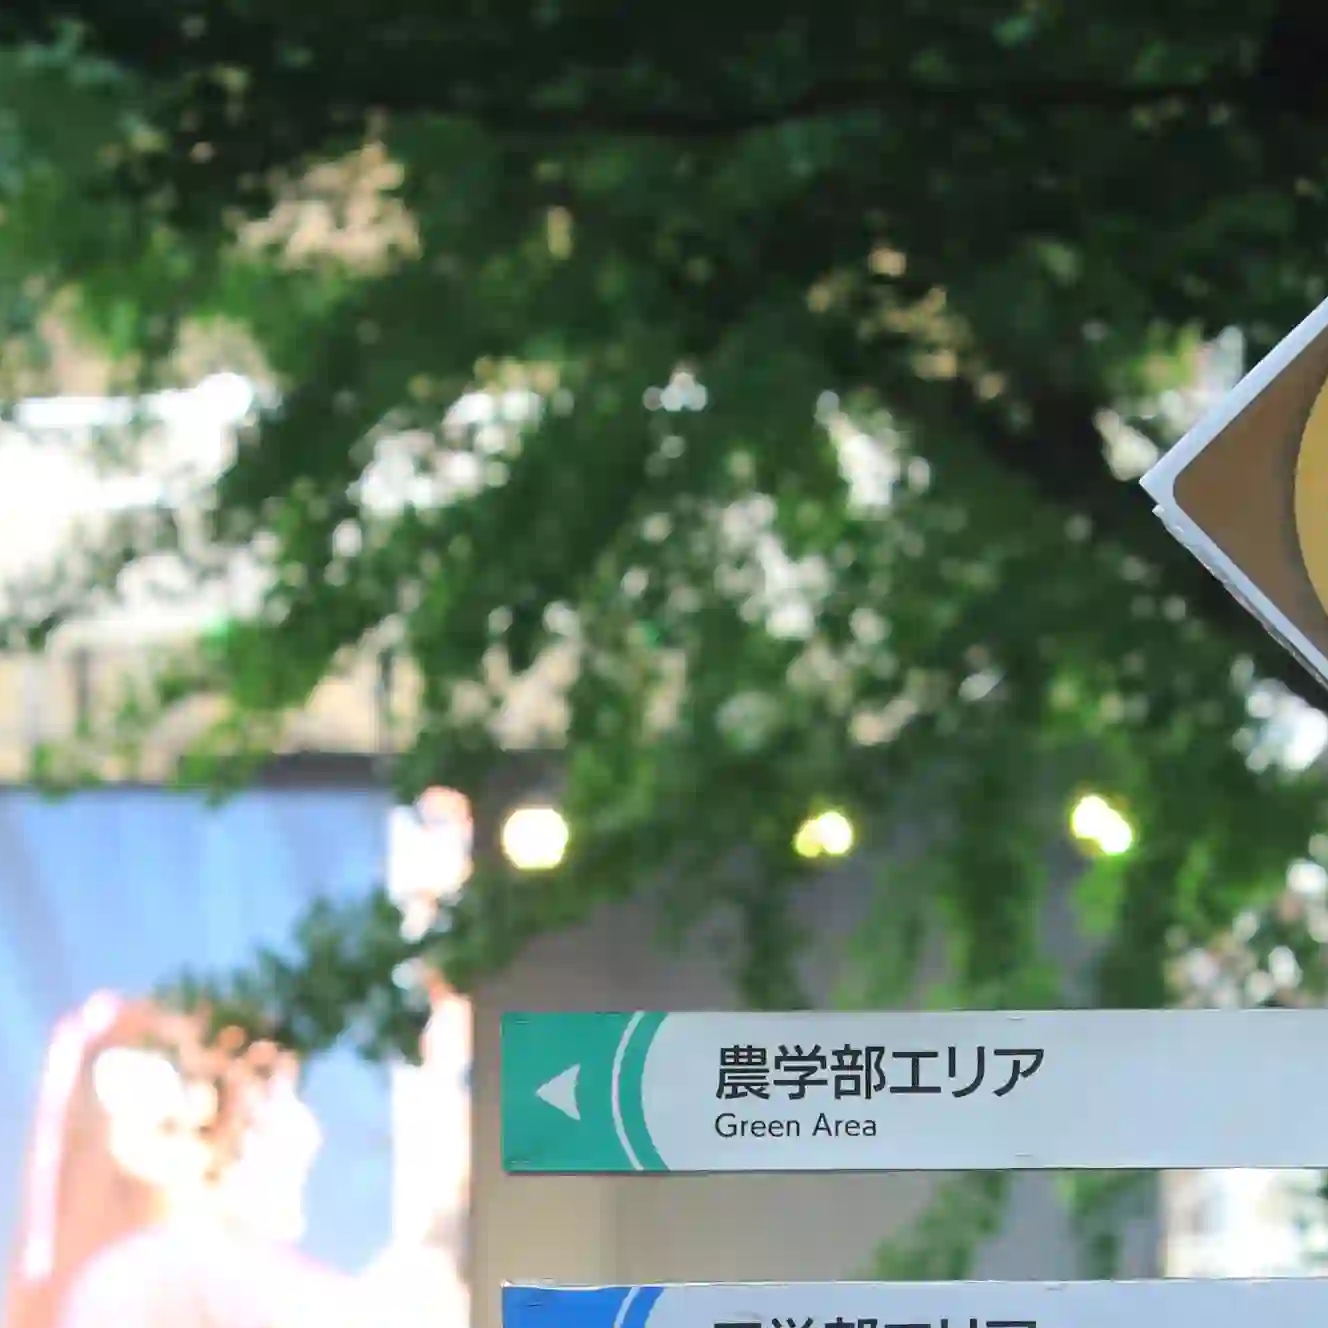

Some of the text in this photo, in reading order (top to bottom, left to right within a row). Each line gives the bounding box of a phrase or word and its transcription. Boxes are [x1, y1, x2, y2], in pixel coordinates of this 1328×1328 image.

[715, 1043, 1045, 1101] 農学部エリア
[715, 1112, 877, 1138] Green Area
